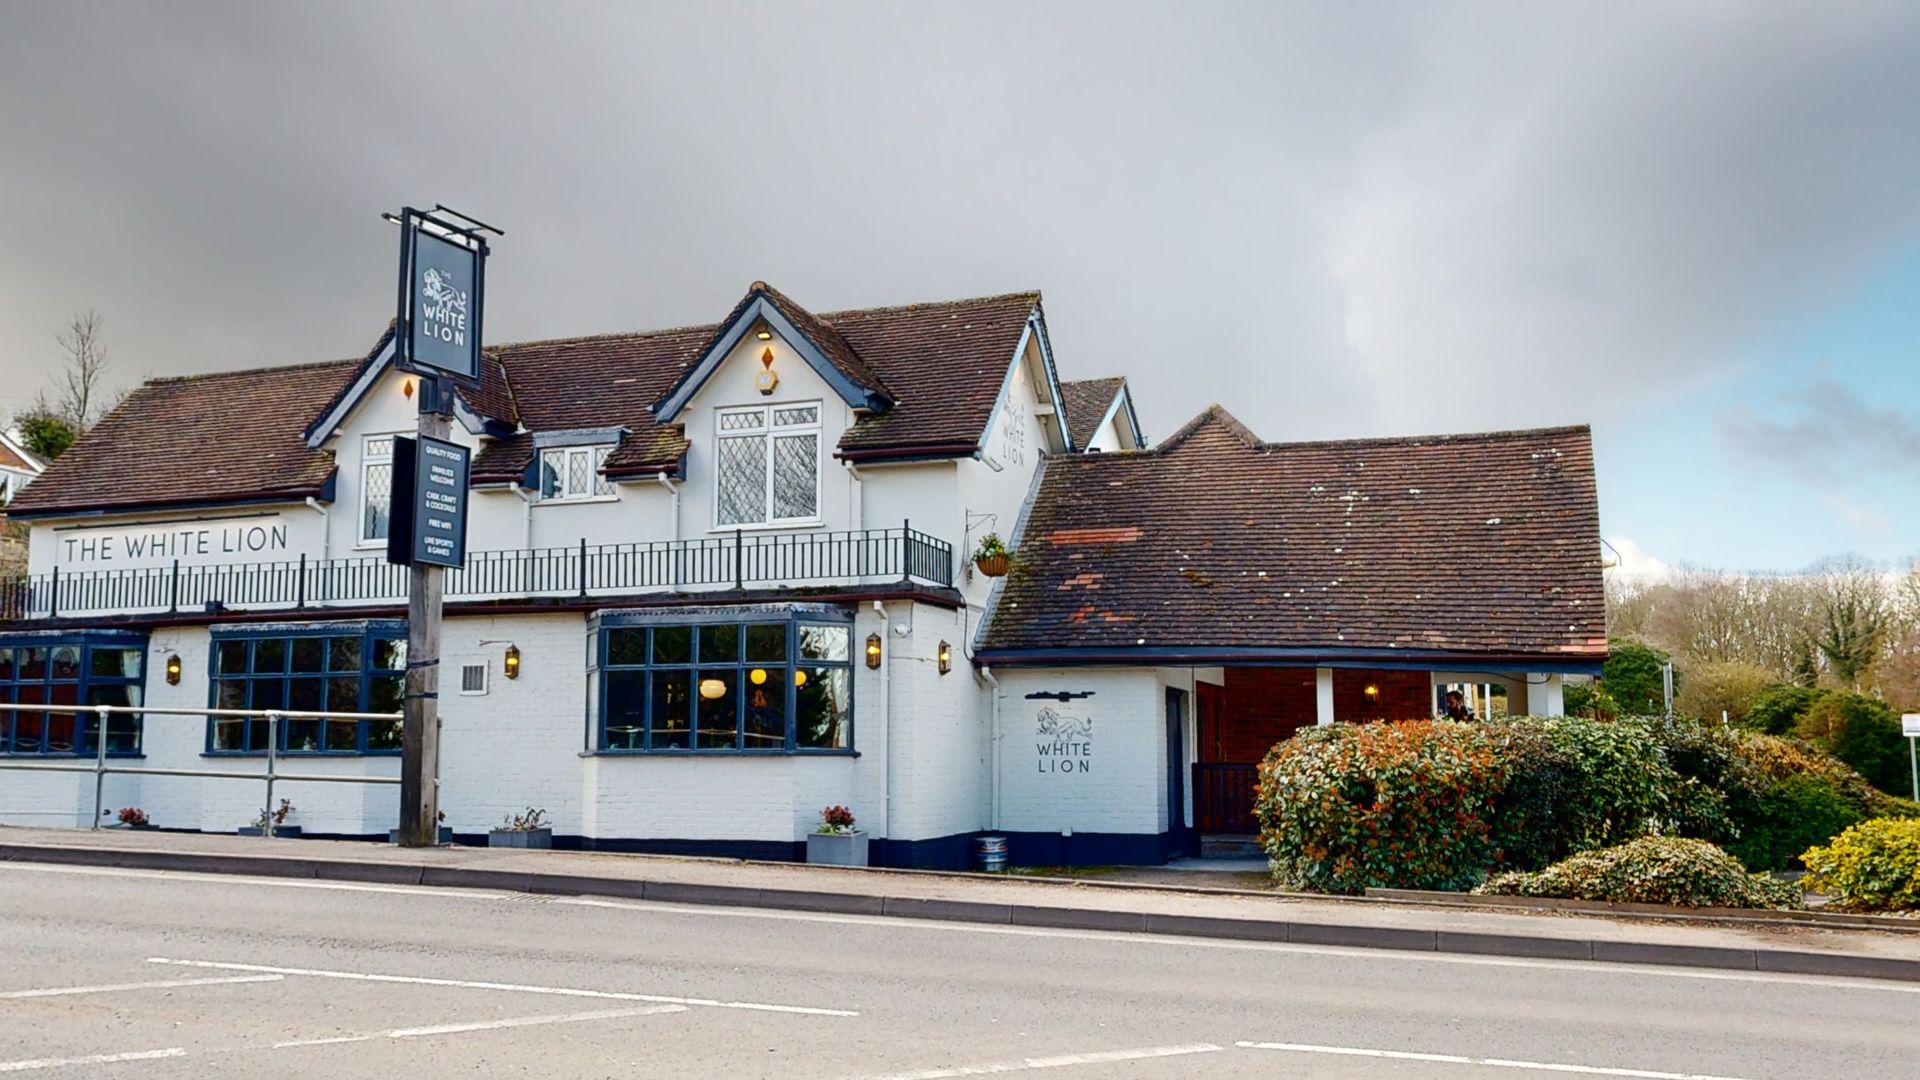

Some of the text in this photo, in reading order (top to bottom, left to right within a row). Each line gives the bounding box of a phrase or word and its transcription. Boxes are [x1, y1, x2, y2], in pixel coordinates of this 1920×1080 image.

[423, 303, 466, 330] WHITE
[424, 321, 464, 346] LION
[425, 446, 462, 461] QUALITY FOOD
[1003, 442, 1024, 468] LION
[65, 525, 287, 562] THE WHITE LION
[1036, 743, 1091, 756] WHITE
[1038, 760, 1089, 773] LION
